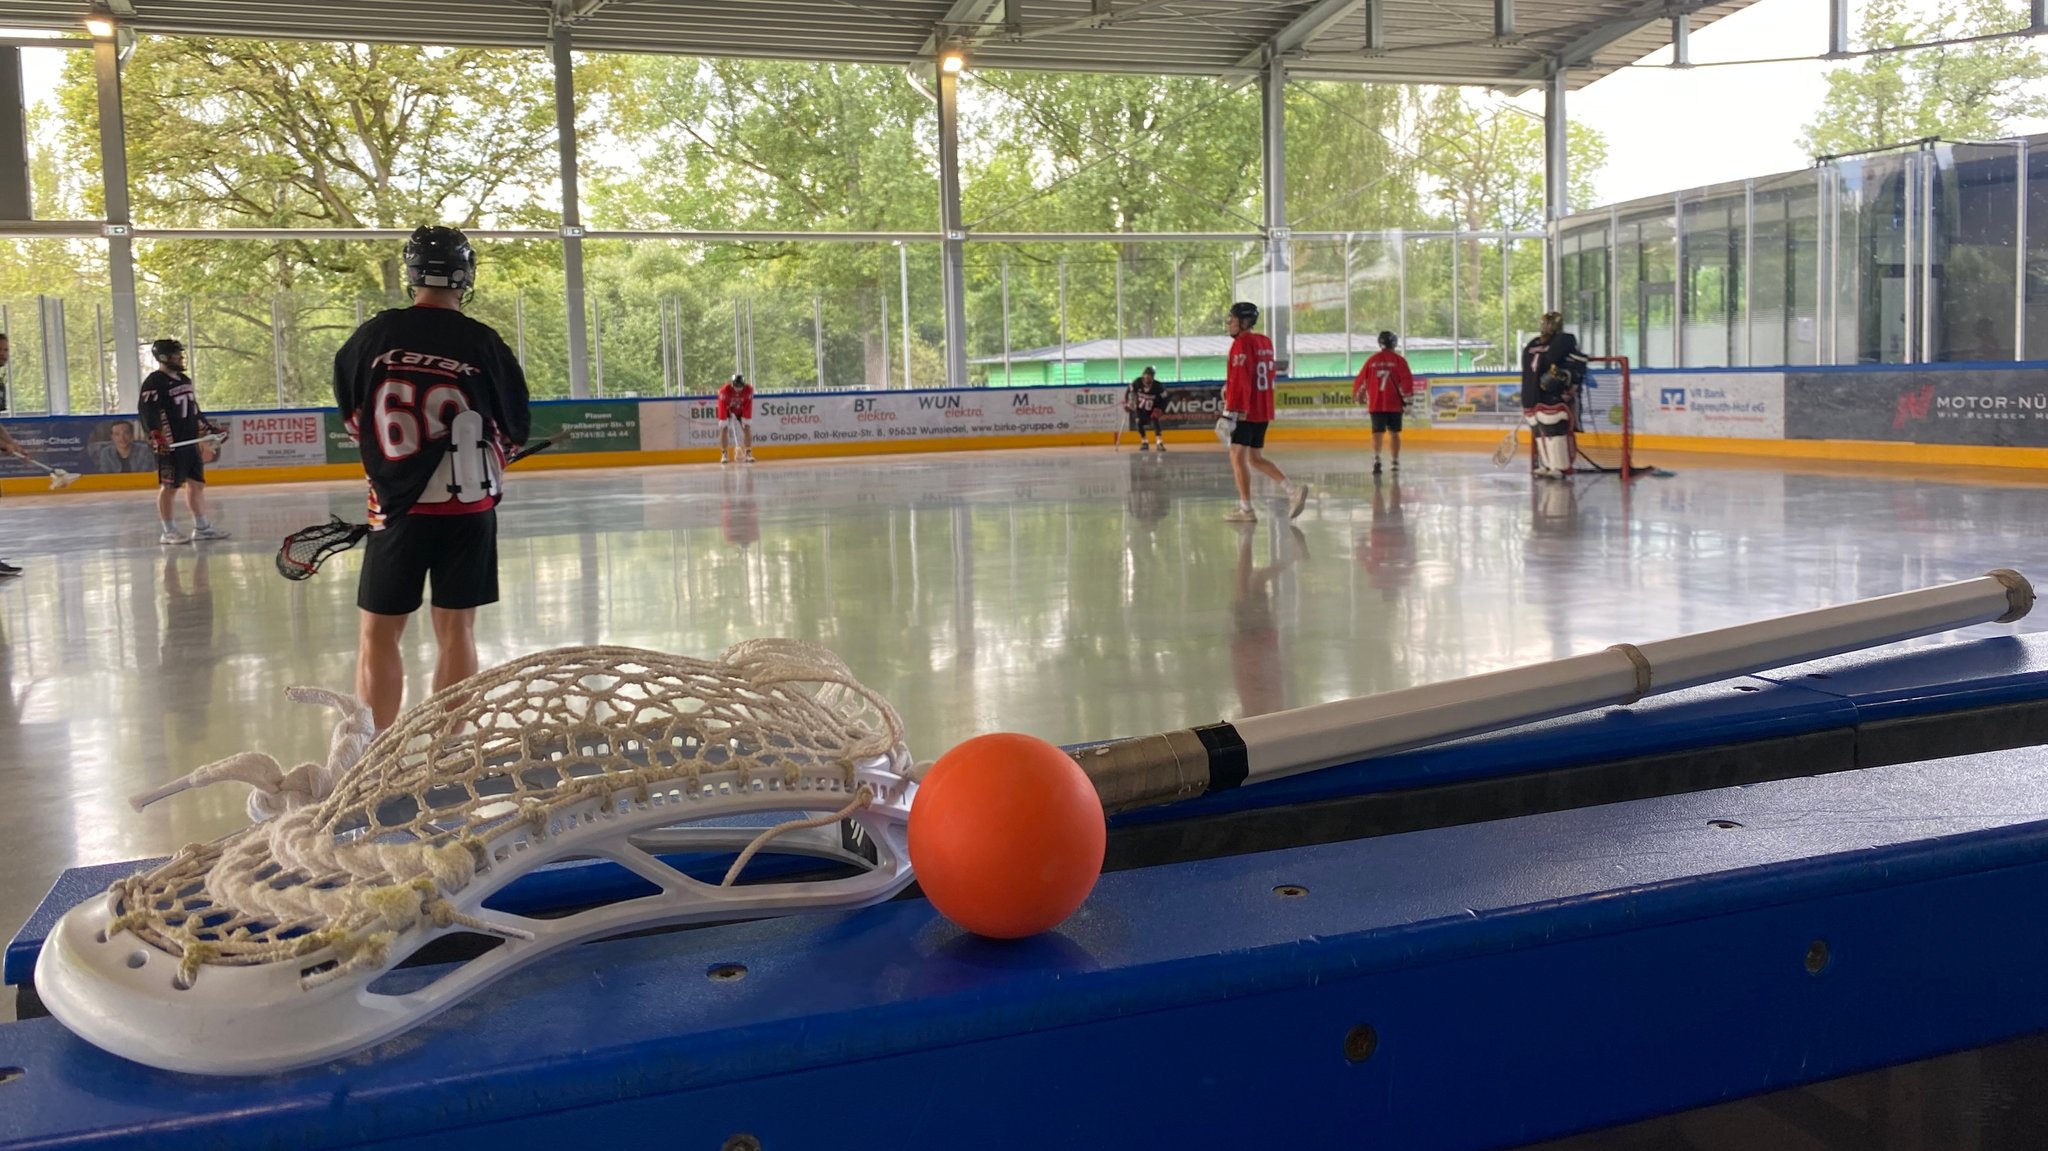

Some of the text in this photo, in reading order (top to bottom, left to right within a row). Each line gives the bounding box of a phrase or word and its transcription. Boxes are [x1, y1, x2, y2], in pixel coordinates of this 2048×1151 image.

[1376, 370, 1391, 391] 7
[1012, 393, 1029, 406] M
[1076, 394, 1115, 405] BIRKE
[1704, 388, 1726, 398] Bank
[854, 398, 877, 413] BT
[918, 395, 960, 410] WUN
[1138, 396, 1154, 410] 70
[1936, 393, 2047, 410] MOTOR-NÜ
[585, 412, 612, 420] Plauen
[691, 407, 718, 419] BIR
[760, 402, 815, 417] Steiner
[242, 417, 303, 432] MARTIN
[770, 432, 811, 442] Gruppe,
[889, 427, 917, 437] 95632
[920, 424, 969, 436] Wunsiedel,
